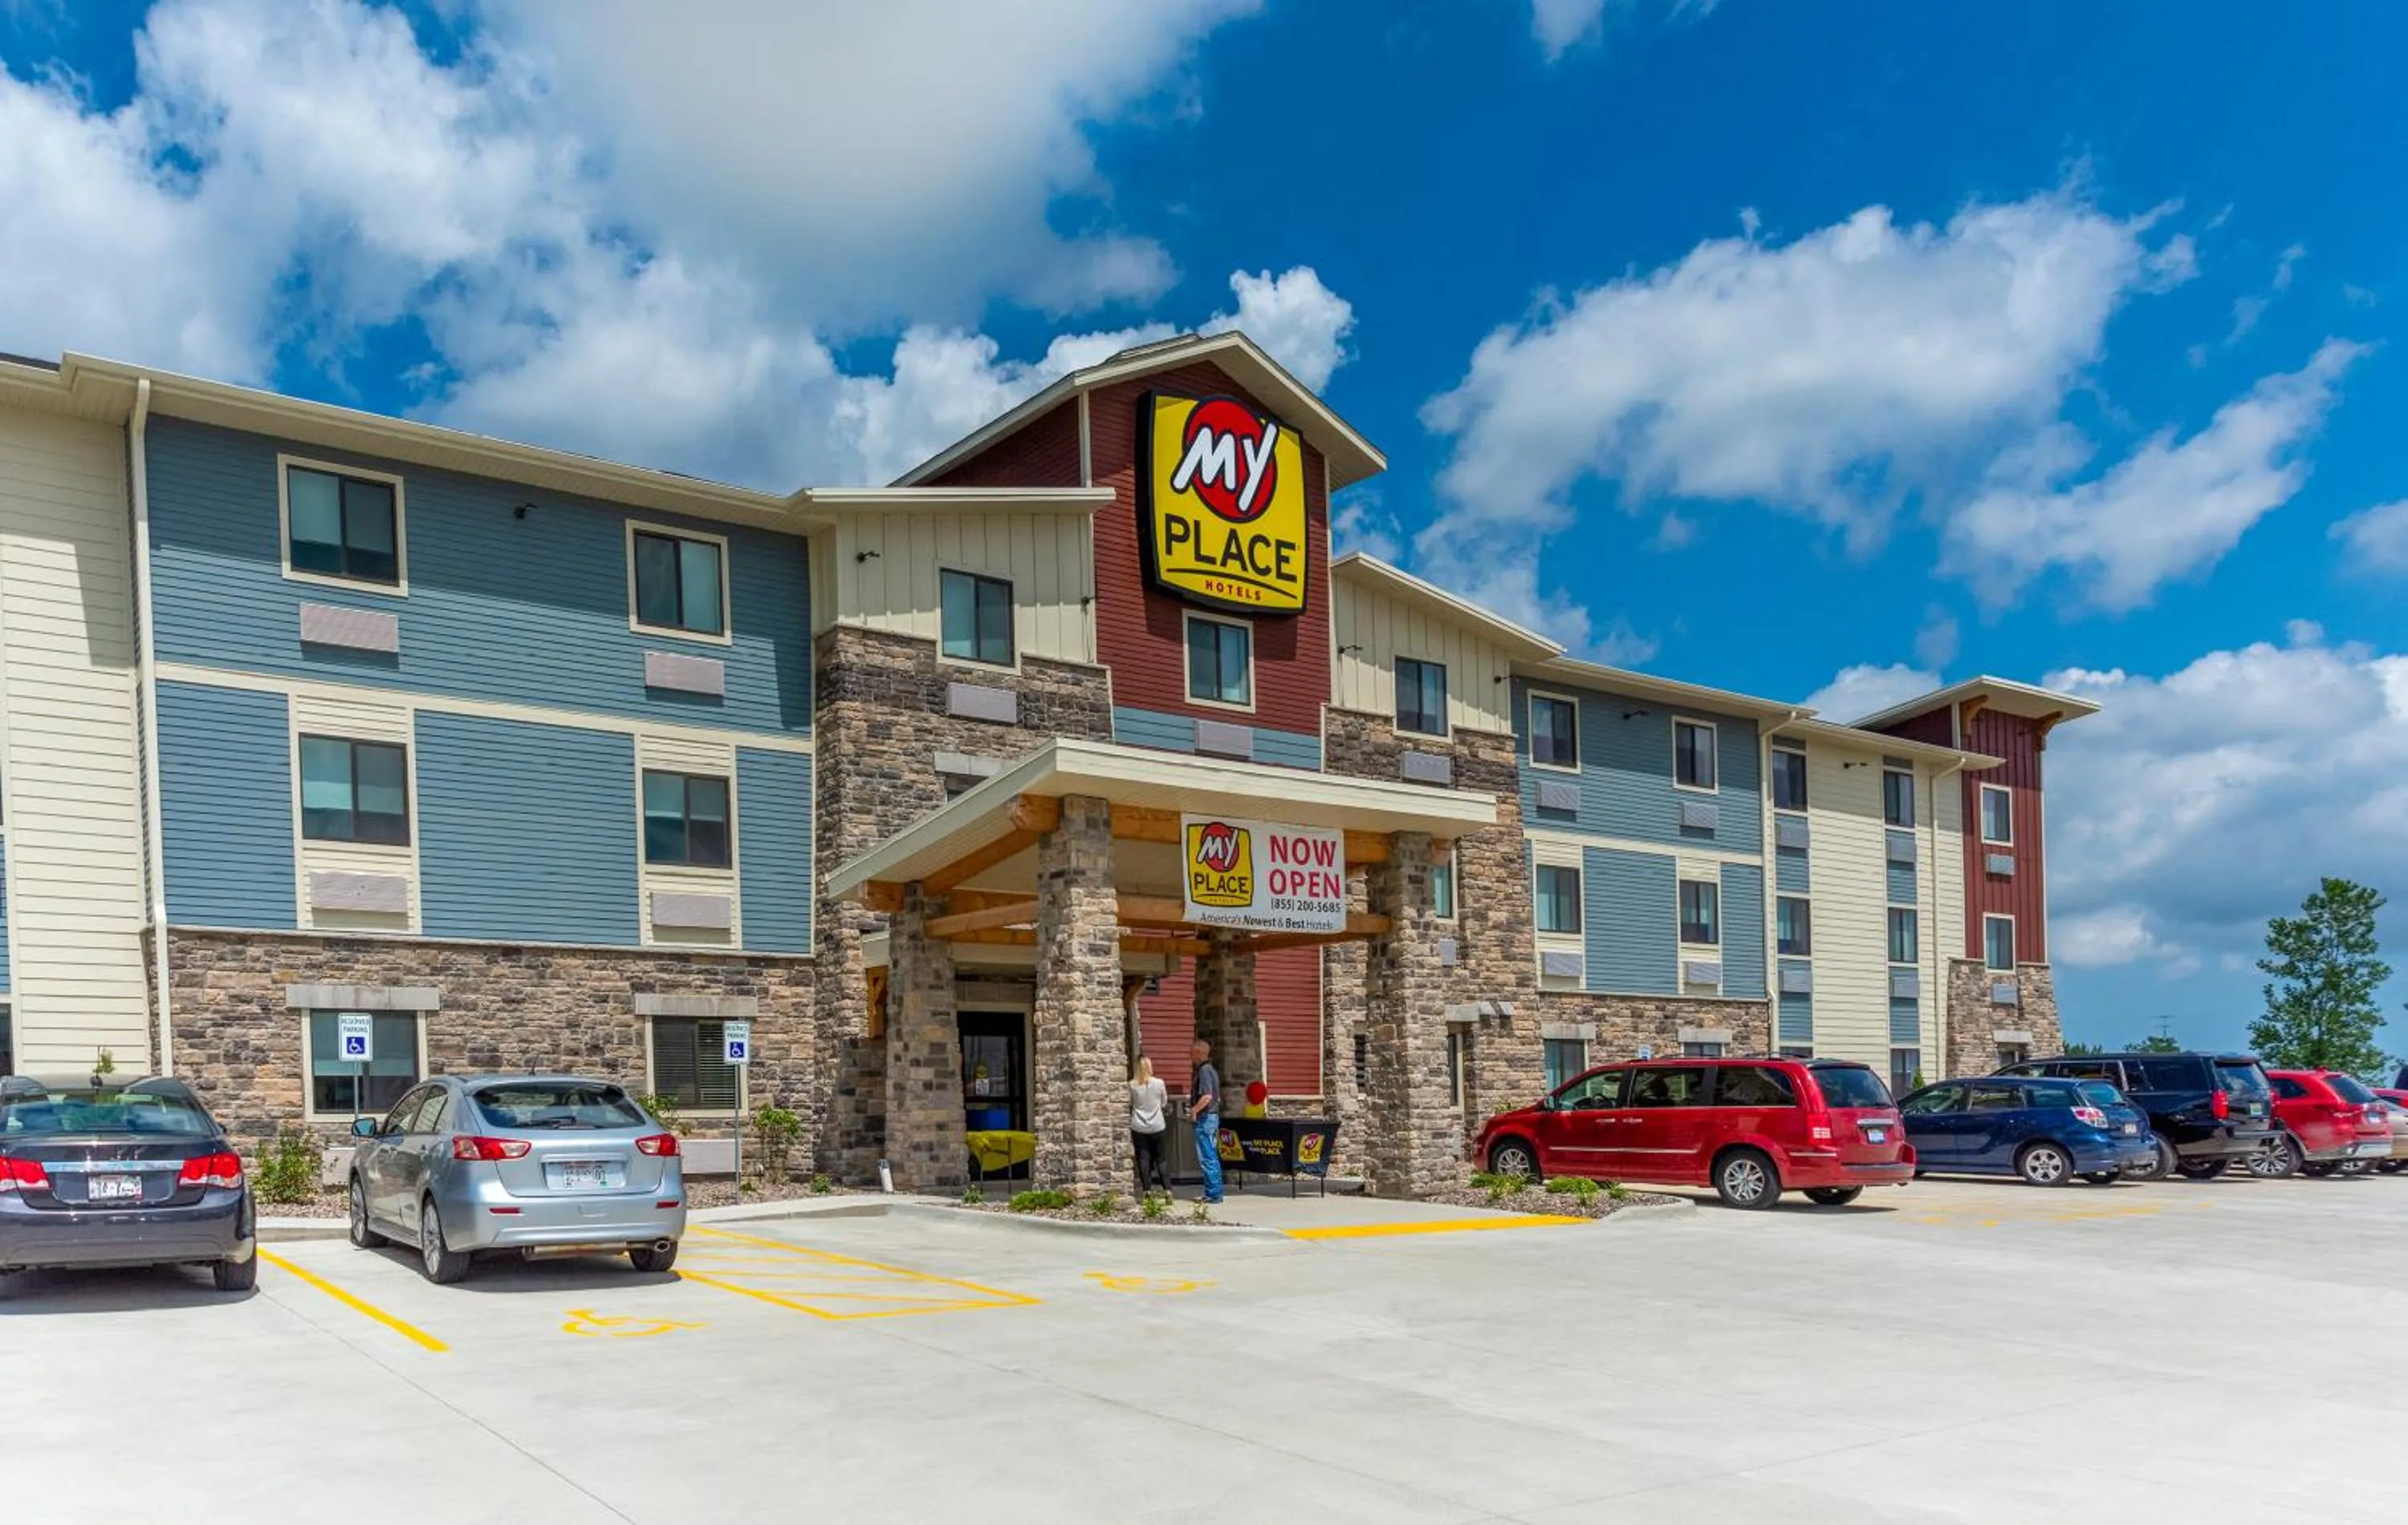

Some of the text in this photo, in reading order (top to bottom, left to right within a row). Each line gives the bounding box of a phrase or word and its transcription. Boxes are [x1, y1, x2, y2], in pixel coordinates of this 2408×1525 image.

[1165, 513, 1298, 584] PLACE
[1205, 580, 1262, 601] HOTELS
[1269, 834, 1336, 868] NOW
[1194, 872, 1250, 895] PLACE
[1269, 868, 1341, 899] OPEN
[1271, 898, 1341, 913] (855) 200-5685
[1243, 914, 1276, 927] Newest
[1285, 917, 1304, 929] Best
